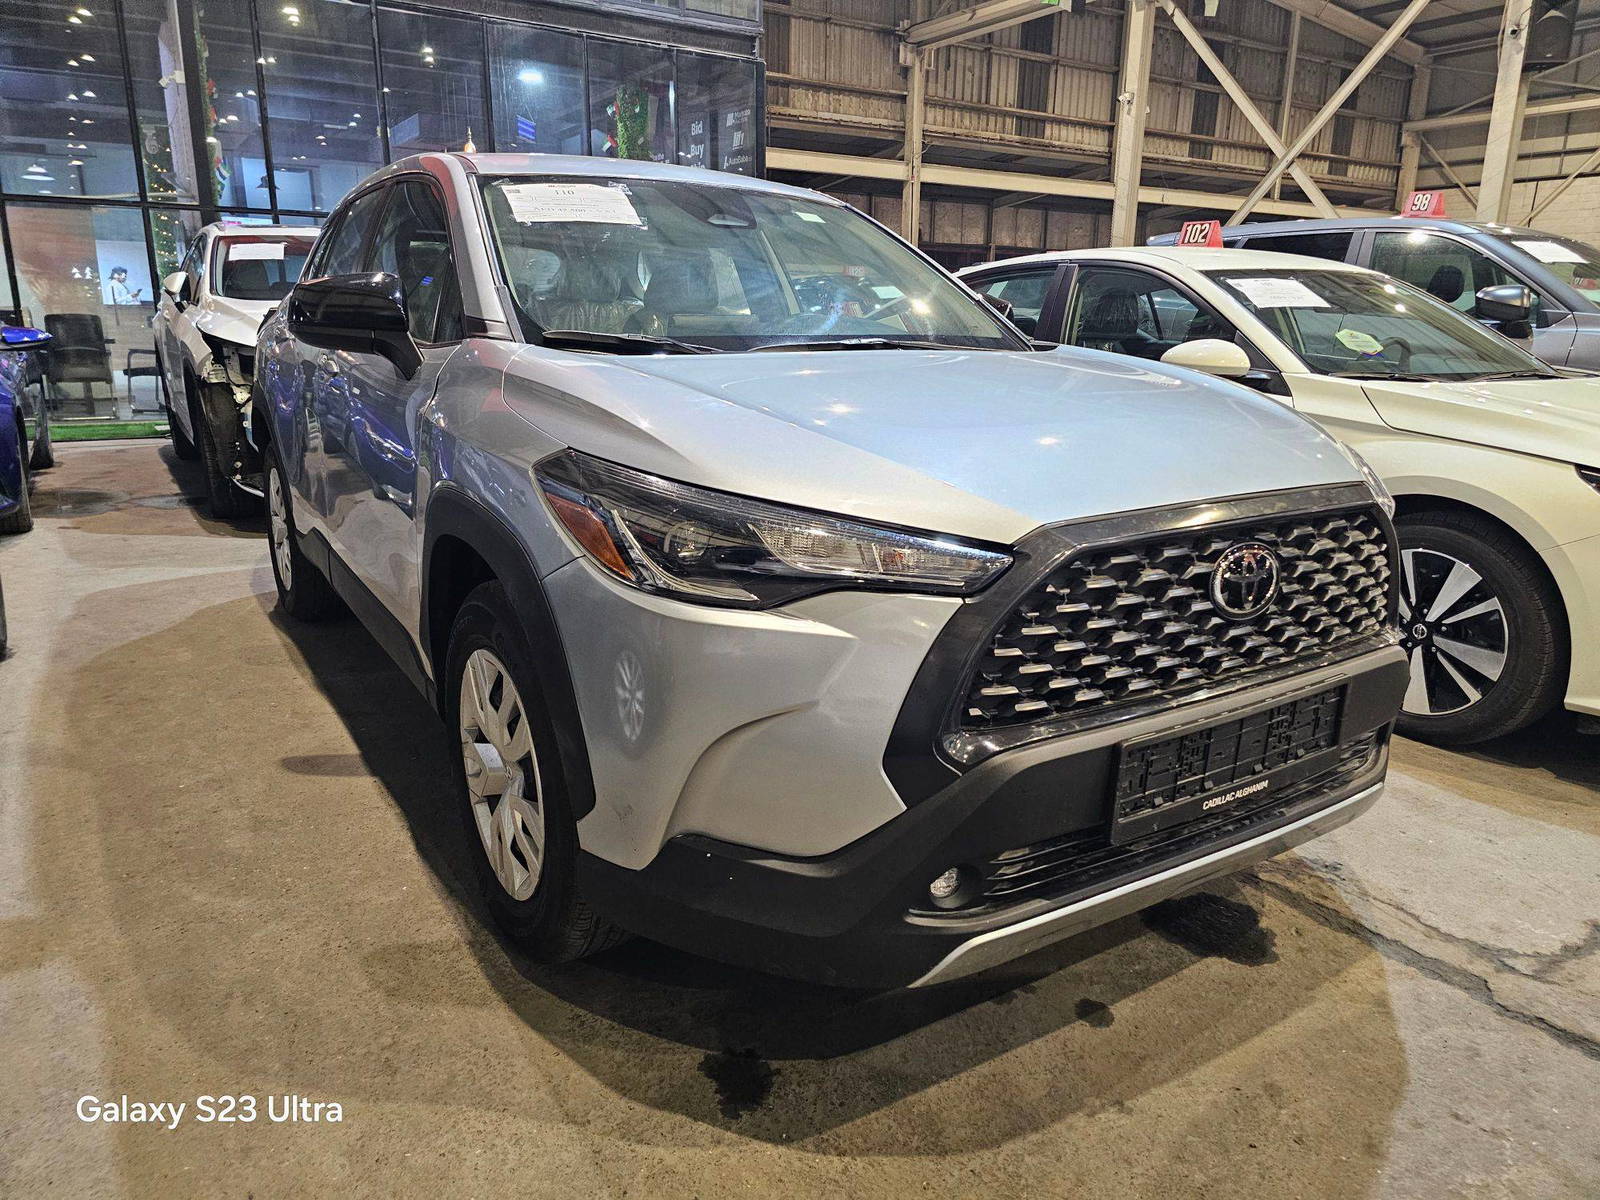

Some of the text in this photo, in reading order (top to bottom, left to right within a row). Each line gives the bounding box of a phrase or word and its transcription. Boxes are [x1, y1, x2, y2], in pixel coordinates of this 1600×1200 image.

[691, 121, 703, 136] Bid
[690, 144, 705, 159] Buy
[1411, 193, 1431, 211] 98
[1184, 223, 1210, 244] 102
[1202, 780, 1269, 810] CADILLAC ALGHANIM
